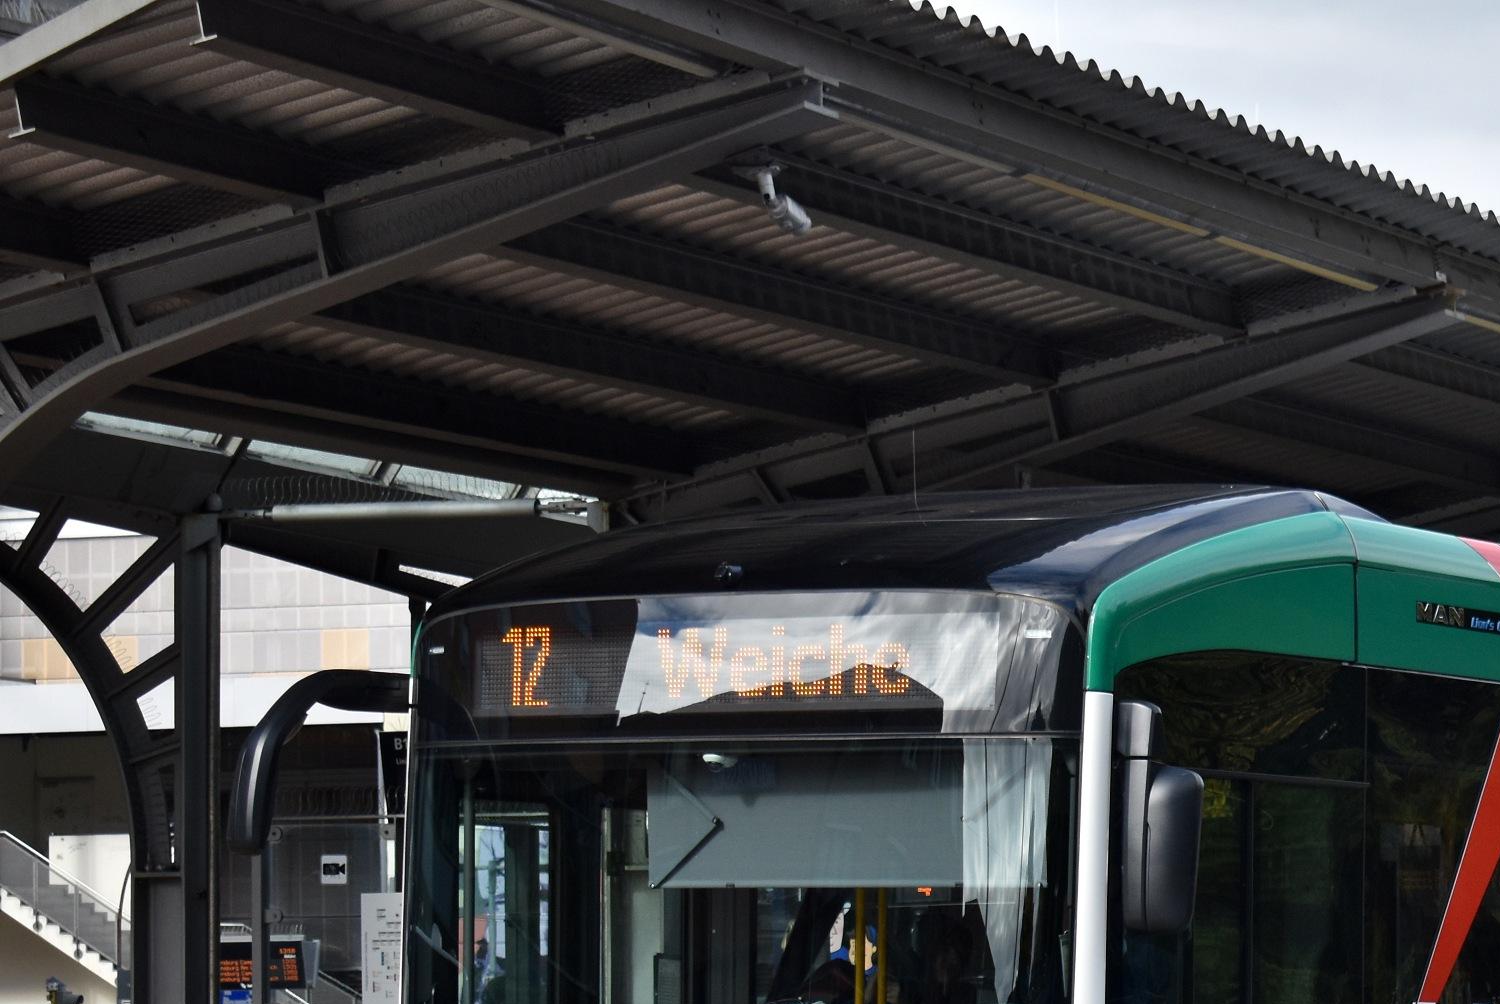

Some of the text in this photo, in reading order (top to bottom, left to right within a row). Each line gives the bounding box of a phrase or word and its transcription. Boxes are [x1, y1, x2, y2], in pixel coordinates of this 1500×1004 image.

[1417, 602, 1464, 628] MAN
[1470, 617, 1494, 632] Lion's
[502, 623, 910, 706] 12 Weiche
